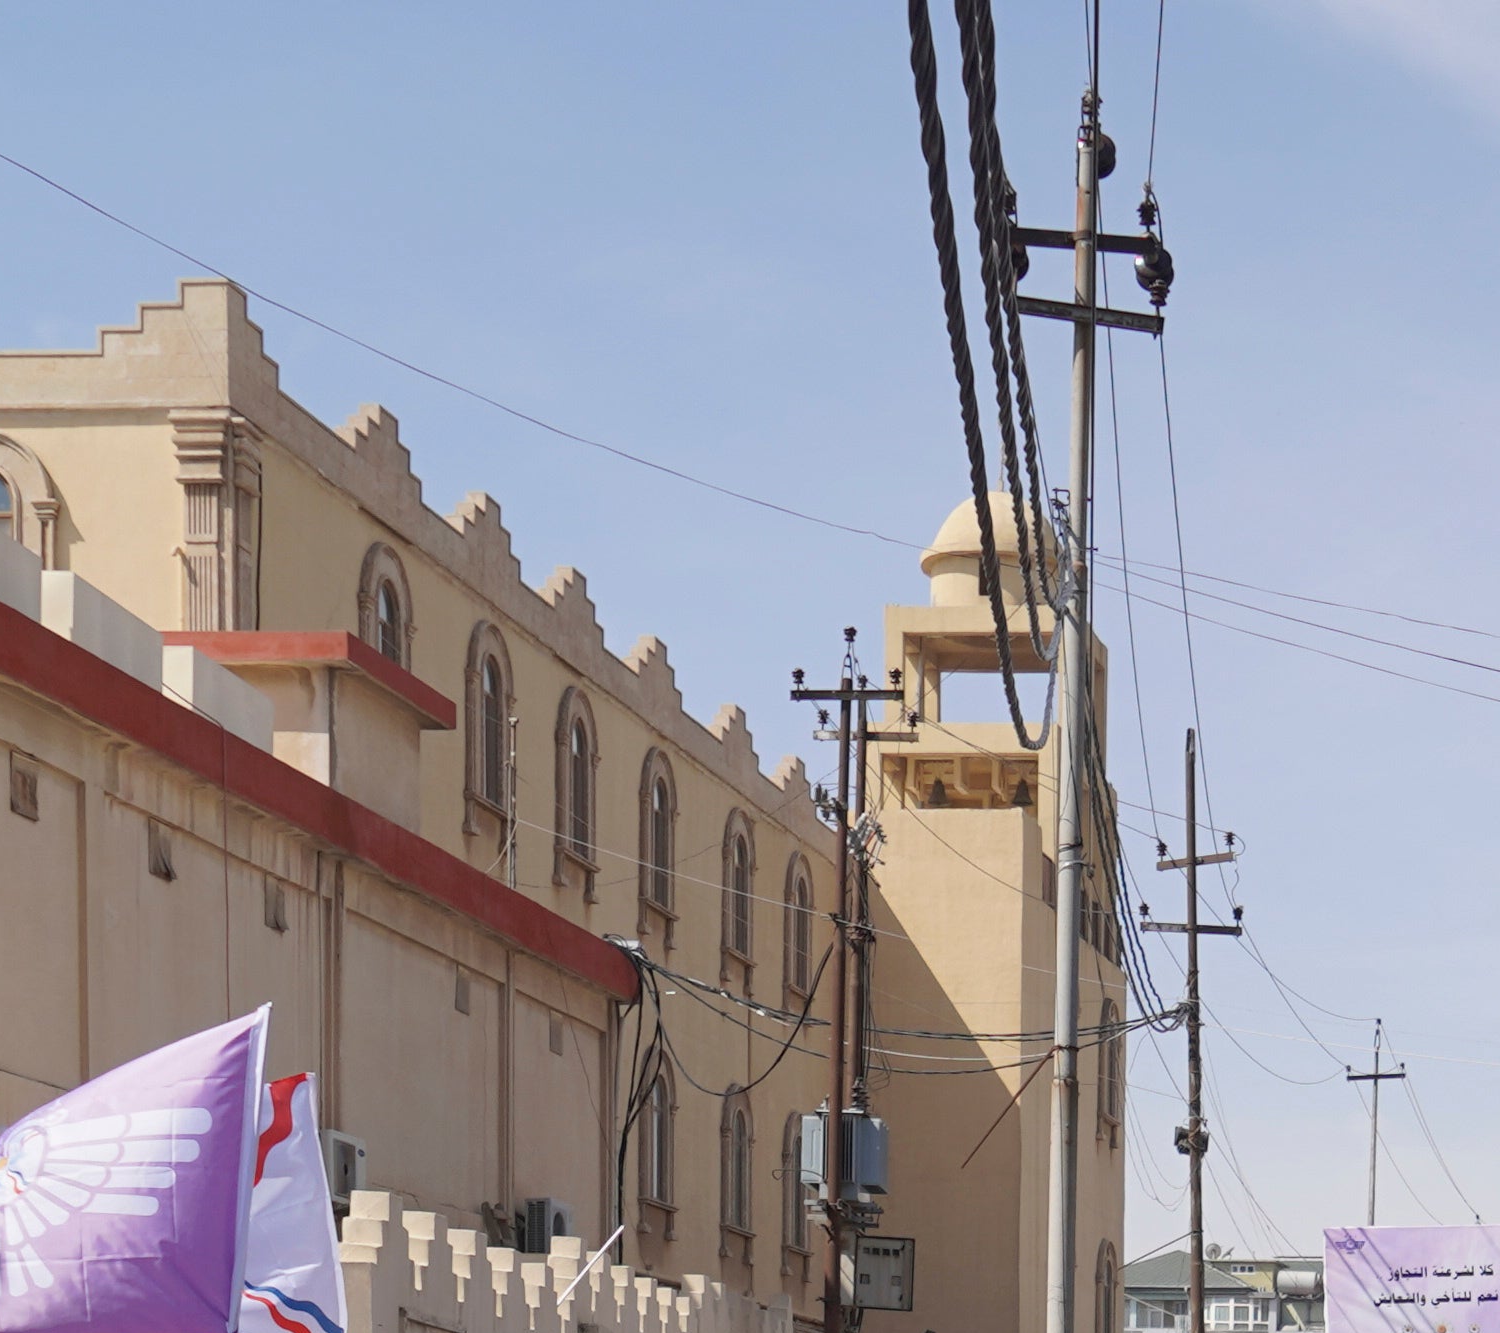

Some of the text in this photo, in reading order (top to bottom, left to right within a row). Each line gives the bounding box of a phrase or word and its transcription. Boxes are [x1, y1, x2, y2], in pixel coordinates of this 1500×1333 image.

[1388, 1266, 1428, 1281] التجاوز
[1479, 1263, 1494, 1276] كلا
[1373, 1292, 1426, 1307] والتعايش
[1477, 1290, 1499, 1306] نعم
